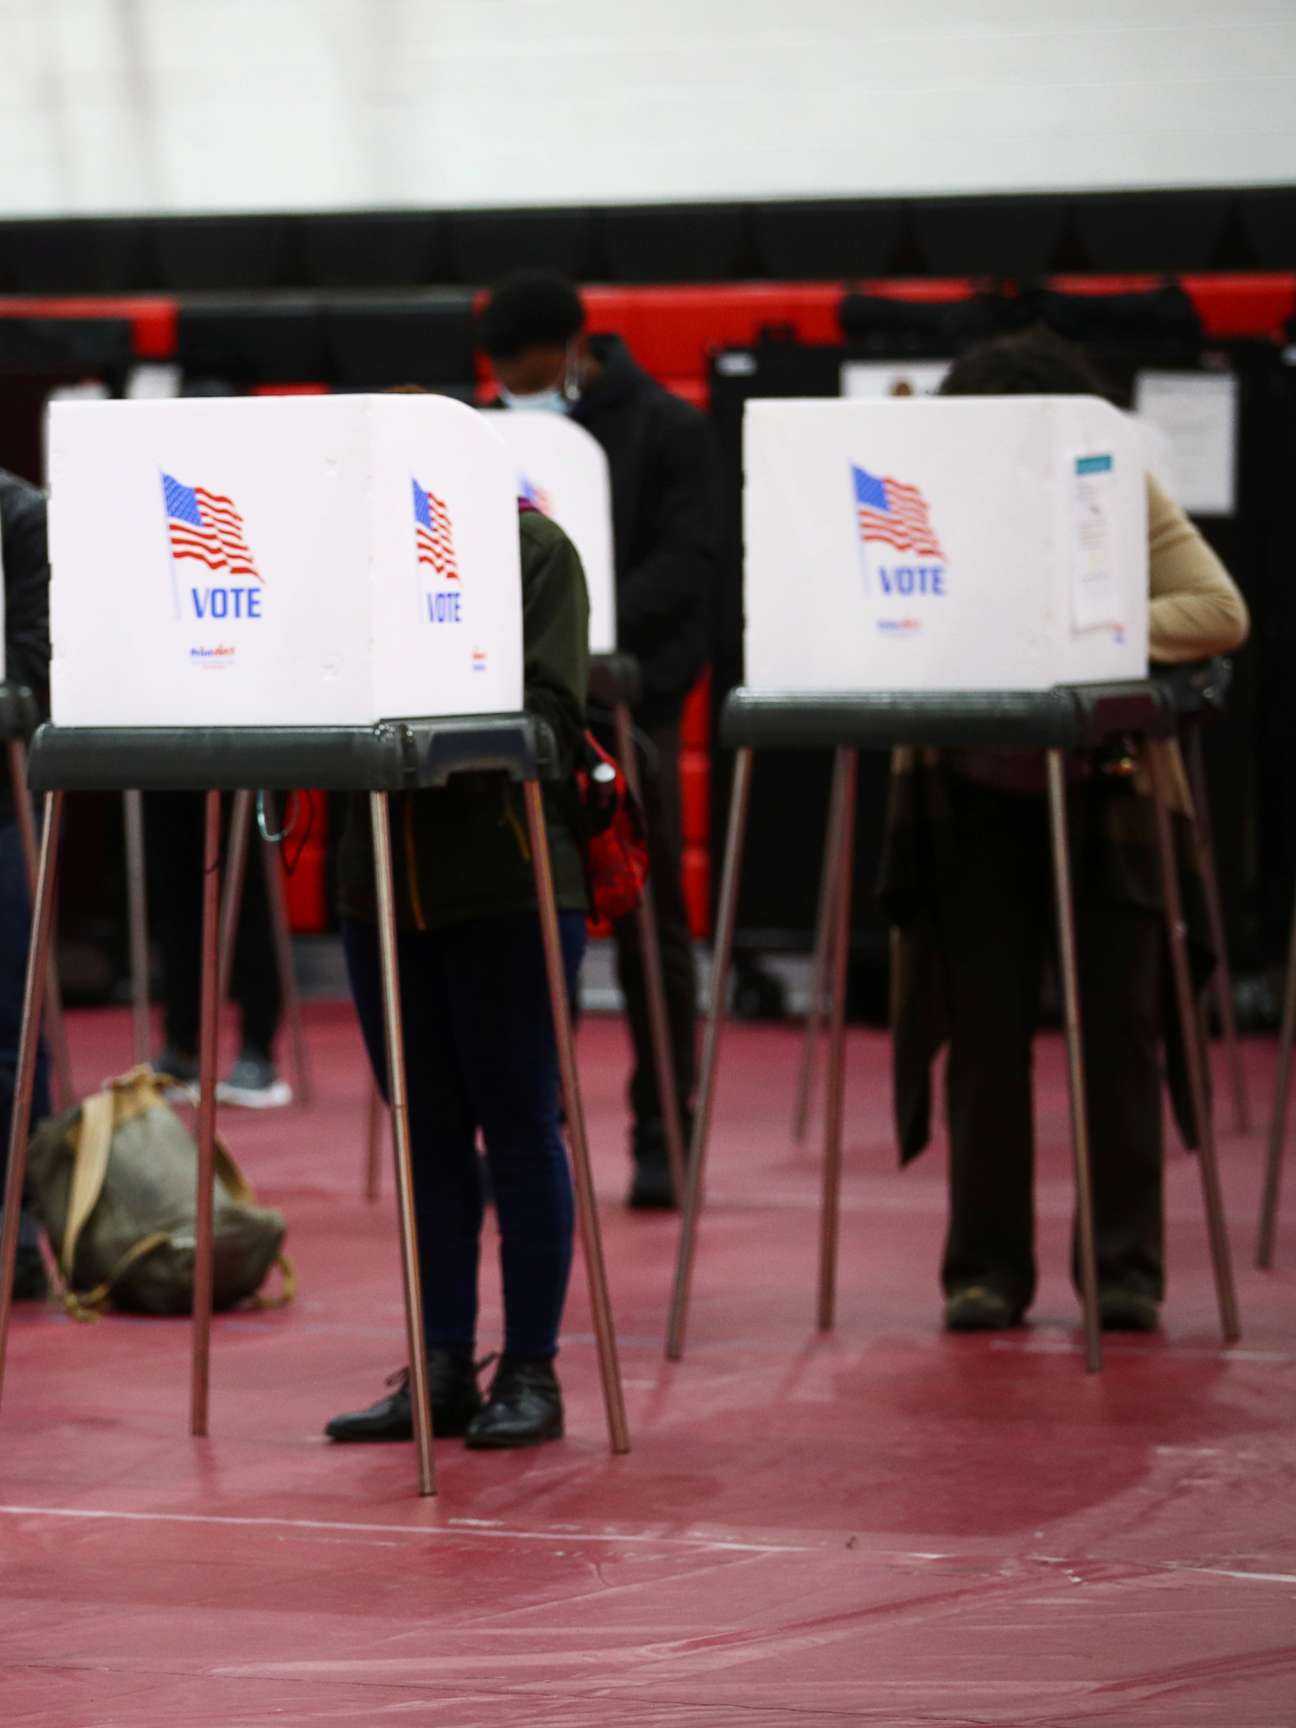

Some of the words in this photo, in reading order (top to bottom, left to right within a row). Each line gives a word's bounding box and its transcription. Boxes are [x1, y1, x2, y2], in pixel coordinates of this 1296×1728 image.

[878, 565, 945, 596] VOTE
[191, 587, 261, 619] VOTE
[427, 591, 461, 623] VOTE
